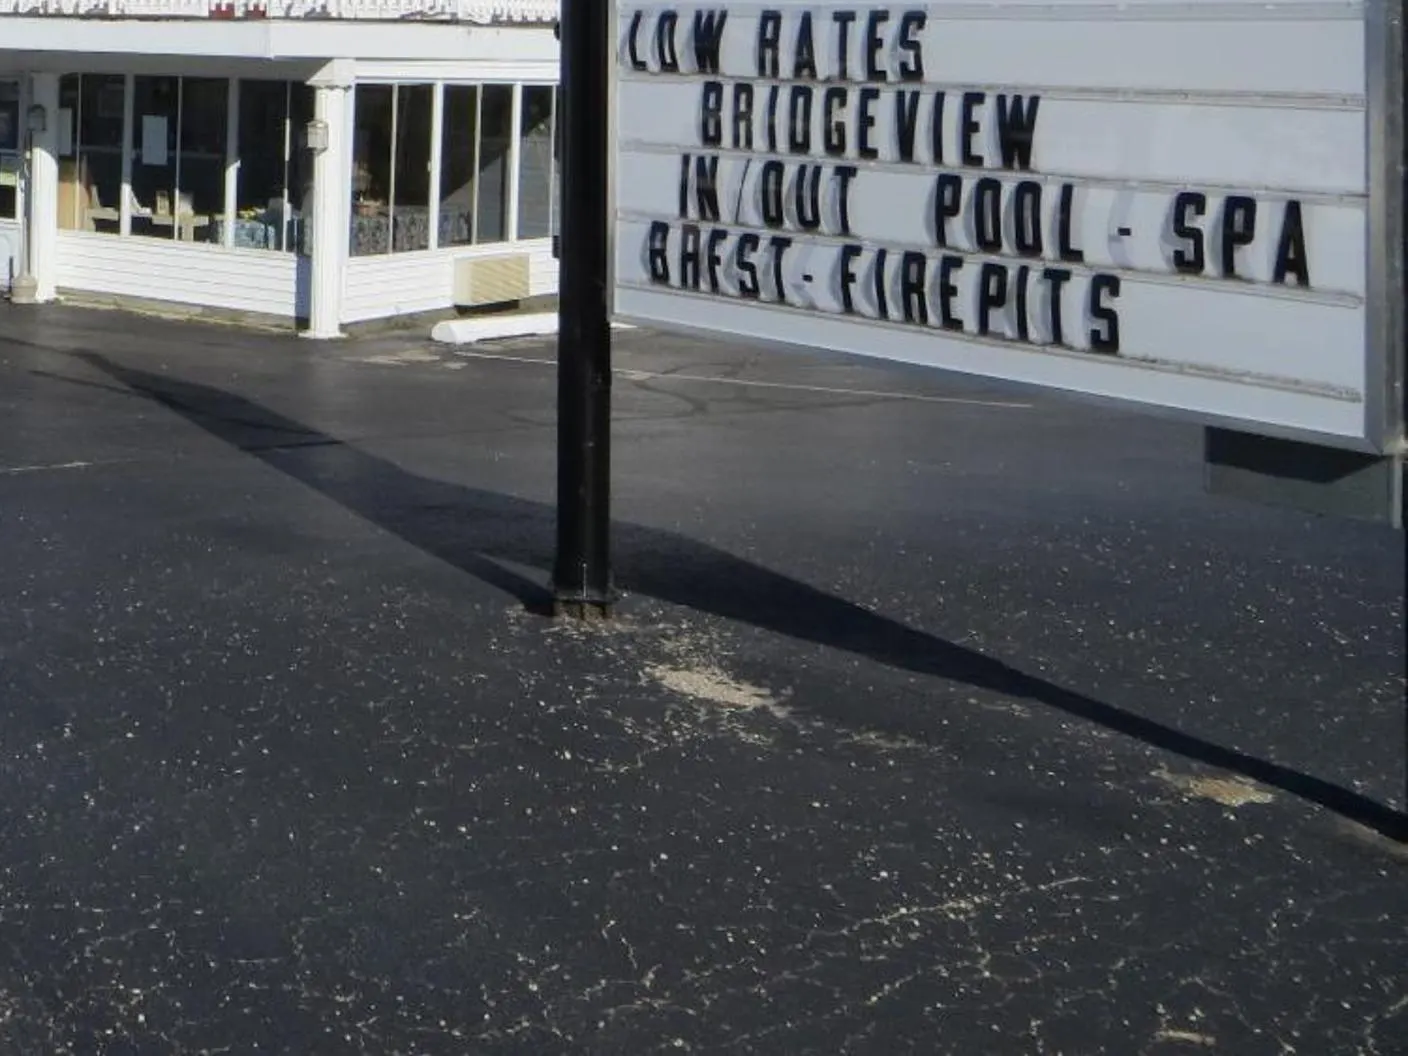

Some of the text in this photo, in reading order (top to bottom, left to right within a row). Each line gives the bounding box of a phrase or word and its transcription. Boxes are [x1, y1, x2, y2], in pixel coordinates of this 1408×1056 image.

[629, 9, 927, 82] LOW RATES
[701, 80, 1041, 171] BRIDGEVIEW
[934, 174, 1083, 263] POOL
[1173, 192, 1309, 287] SPA
